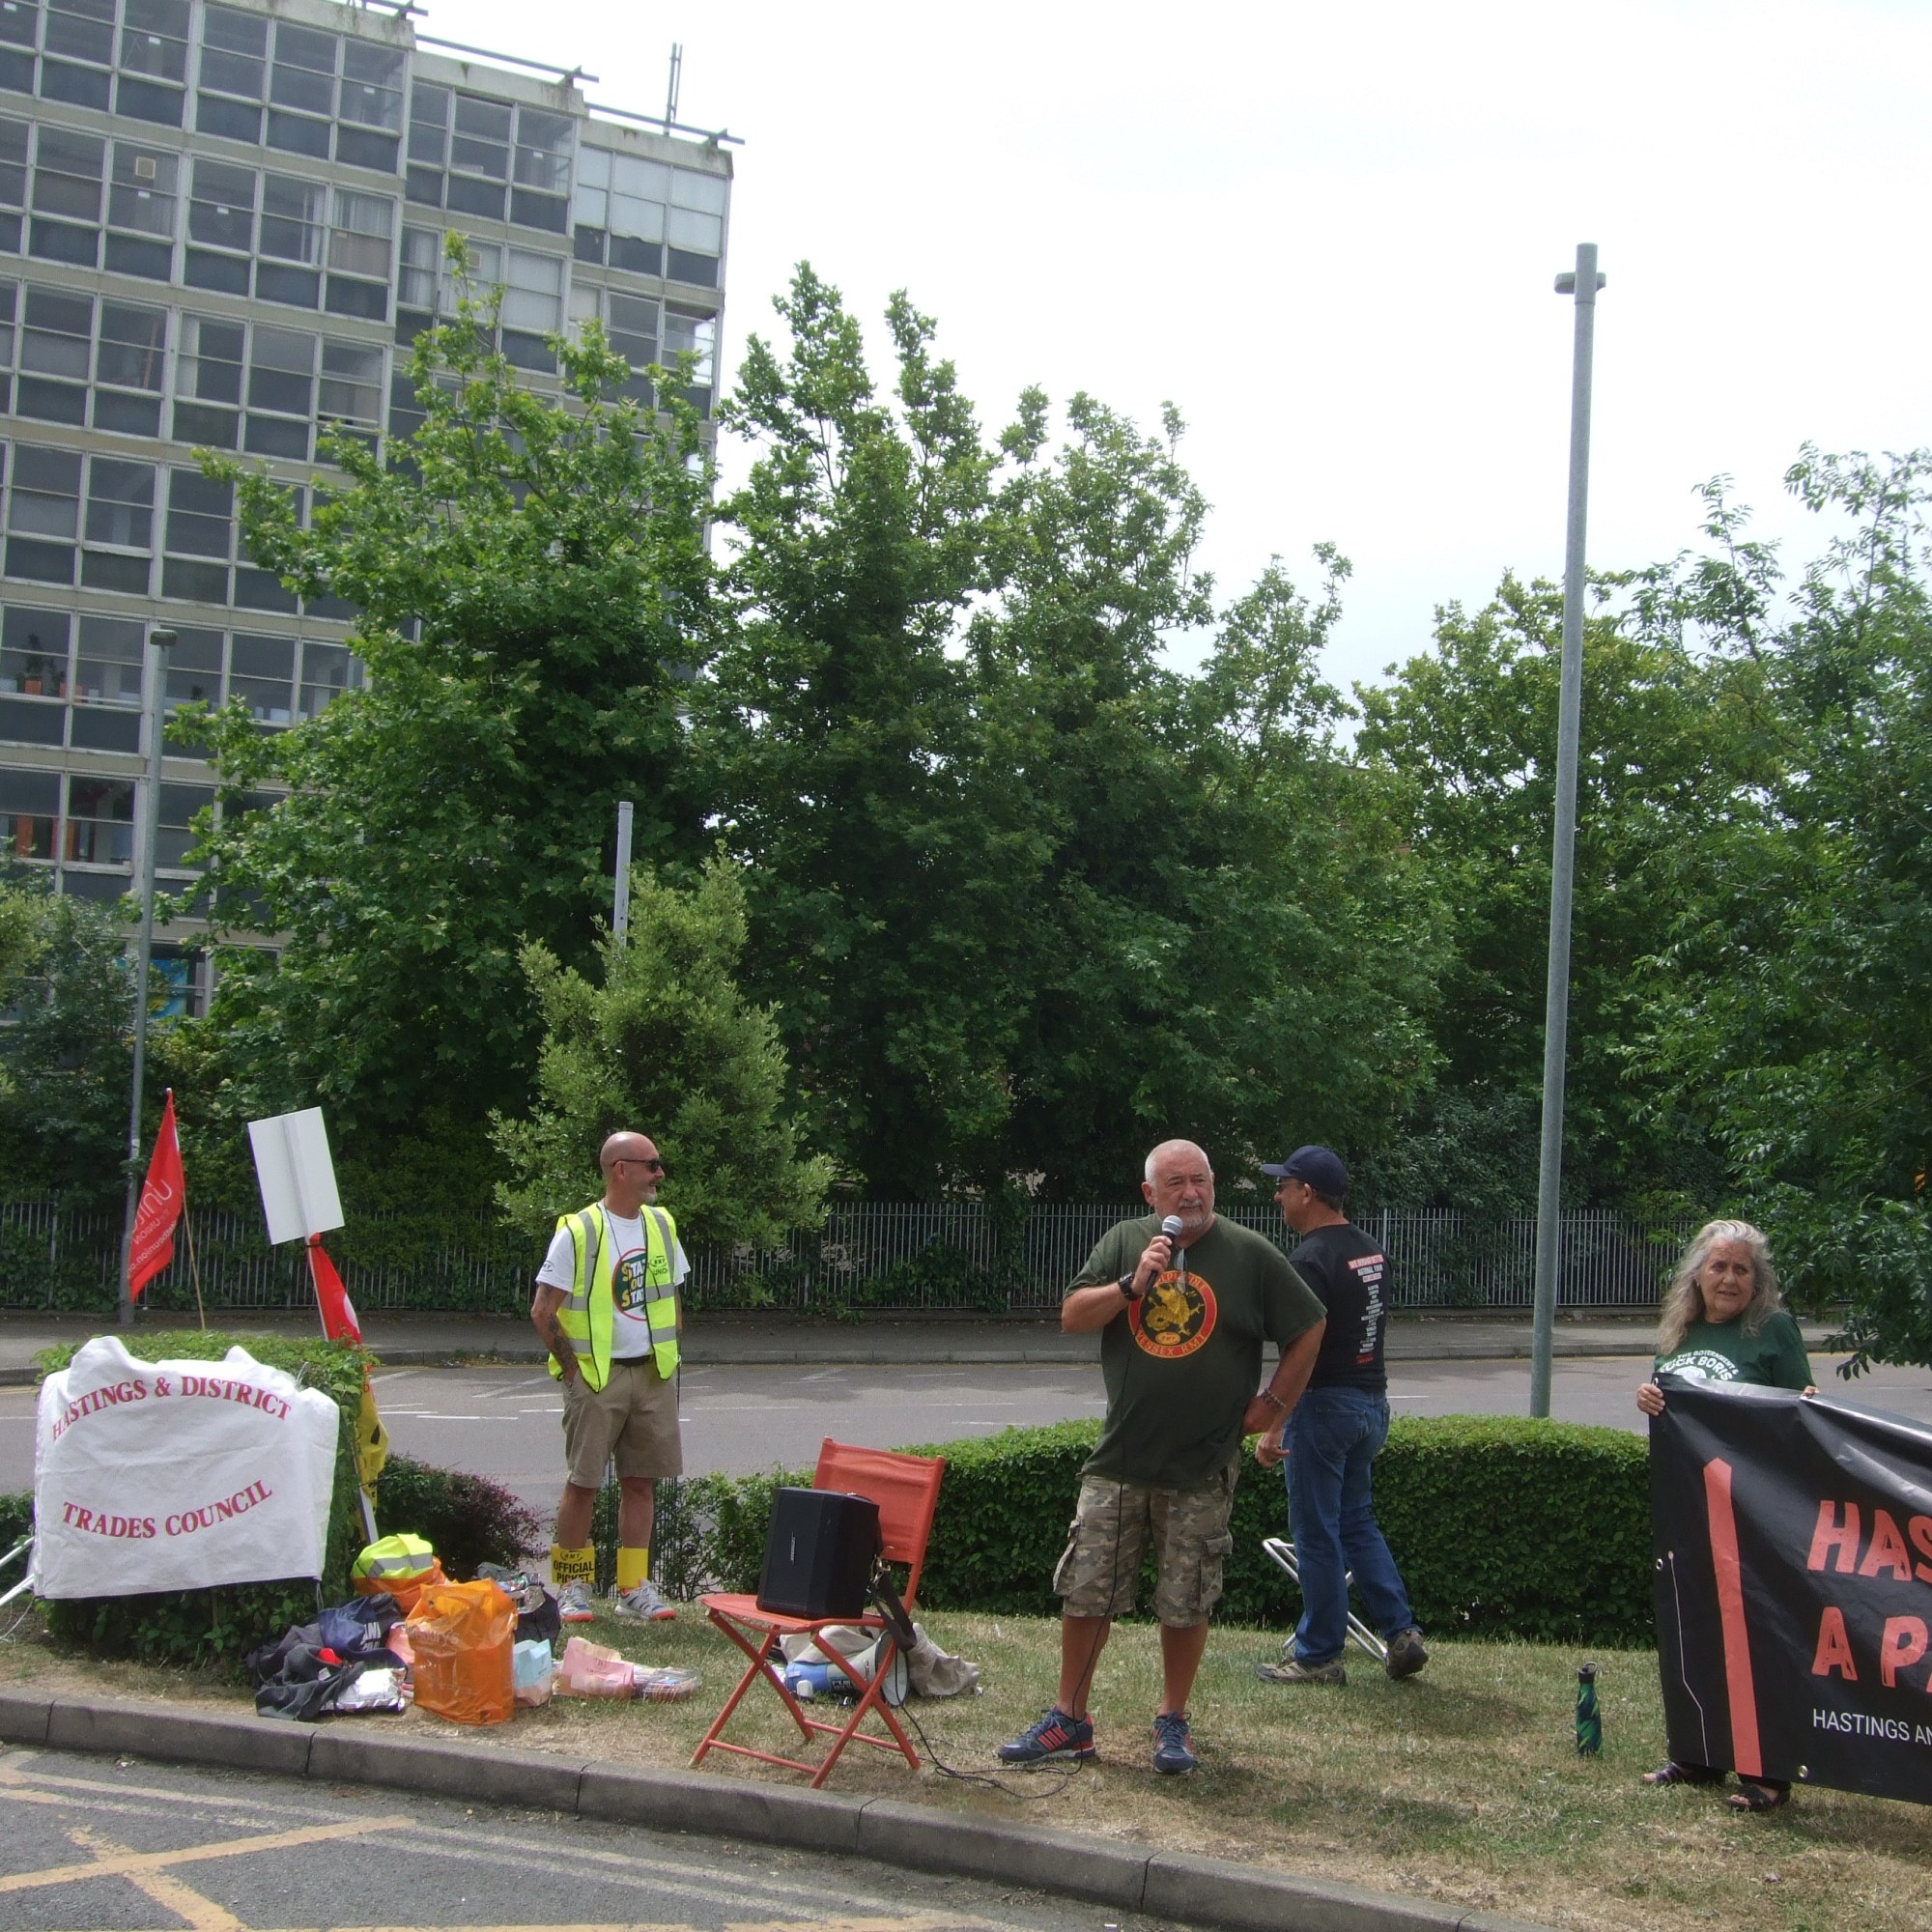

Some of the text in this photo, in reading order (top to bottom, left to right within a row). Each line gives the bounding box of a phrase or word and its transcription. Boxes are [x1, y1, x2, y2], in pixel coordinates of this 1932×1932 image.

[1180, 1335, 1206, 1353] RMT
[1693, 1350, 1735, 1369] GOVERNMENT
[1697, 1356, 1733, 1381] BORIS
[52, 1376, 292, 1442] HASTINGS & DISTRICT
[63, 1479, 273, 1539] TRADES COUNCIL
[554, 1560, 594, 1574] OFFICIAL
[556, 1573, 589, 1584] PICKET
[1811, 1606, 1858, 1681] A
[1812, 1708, 1911, 1741] HASTINGS
